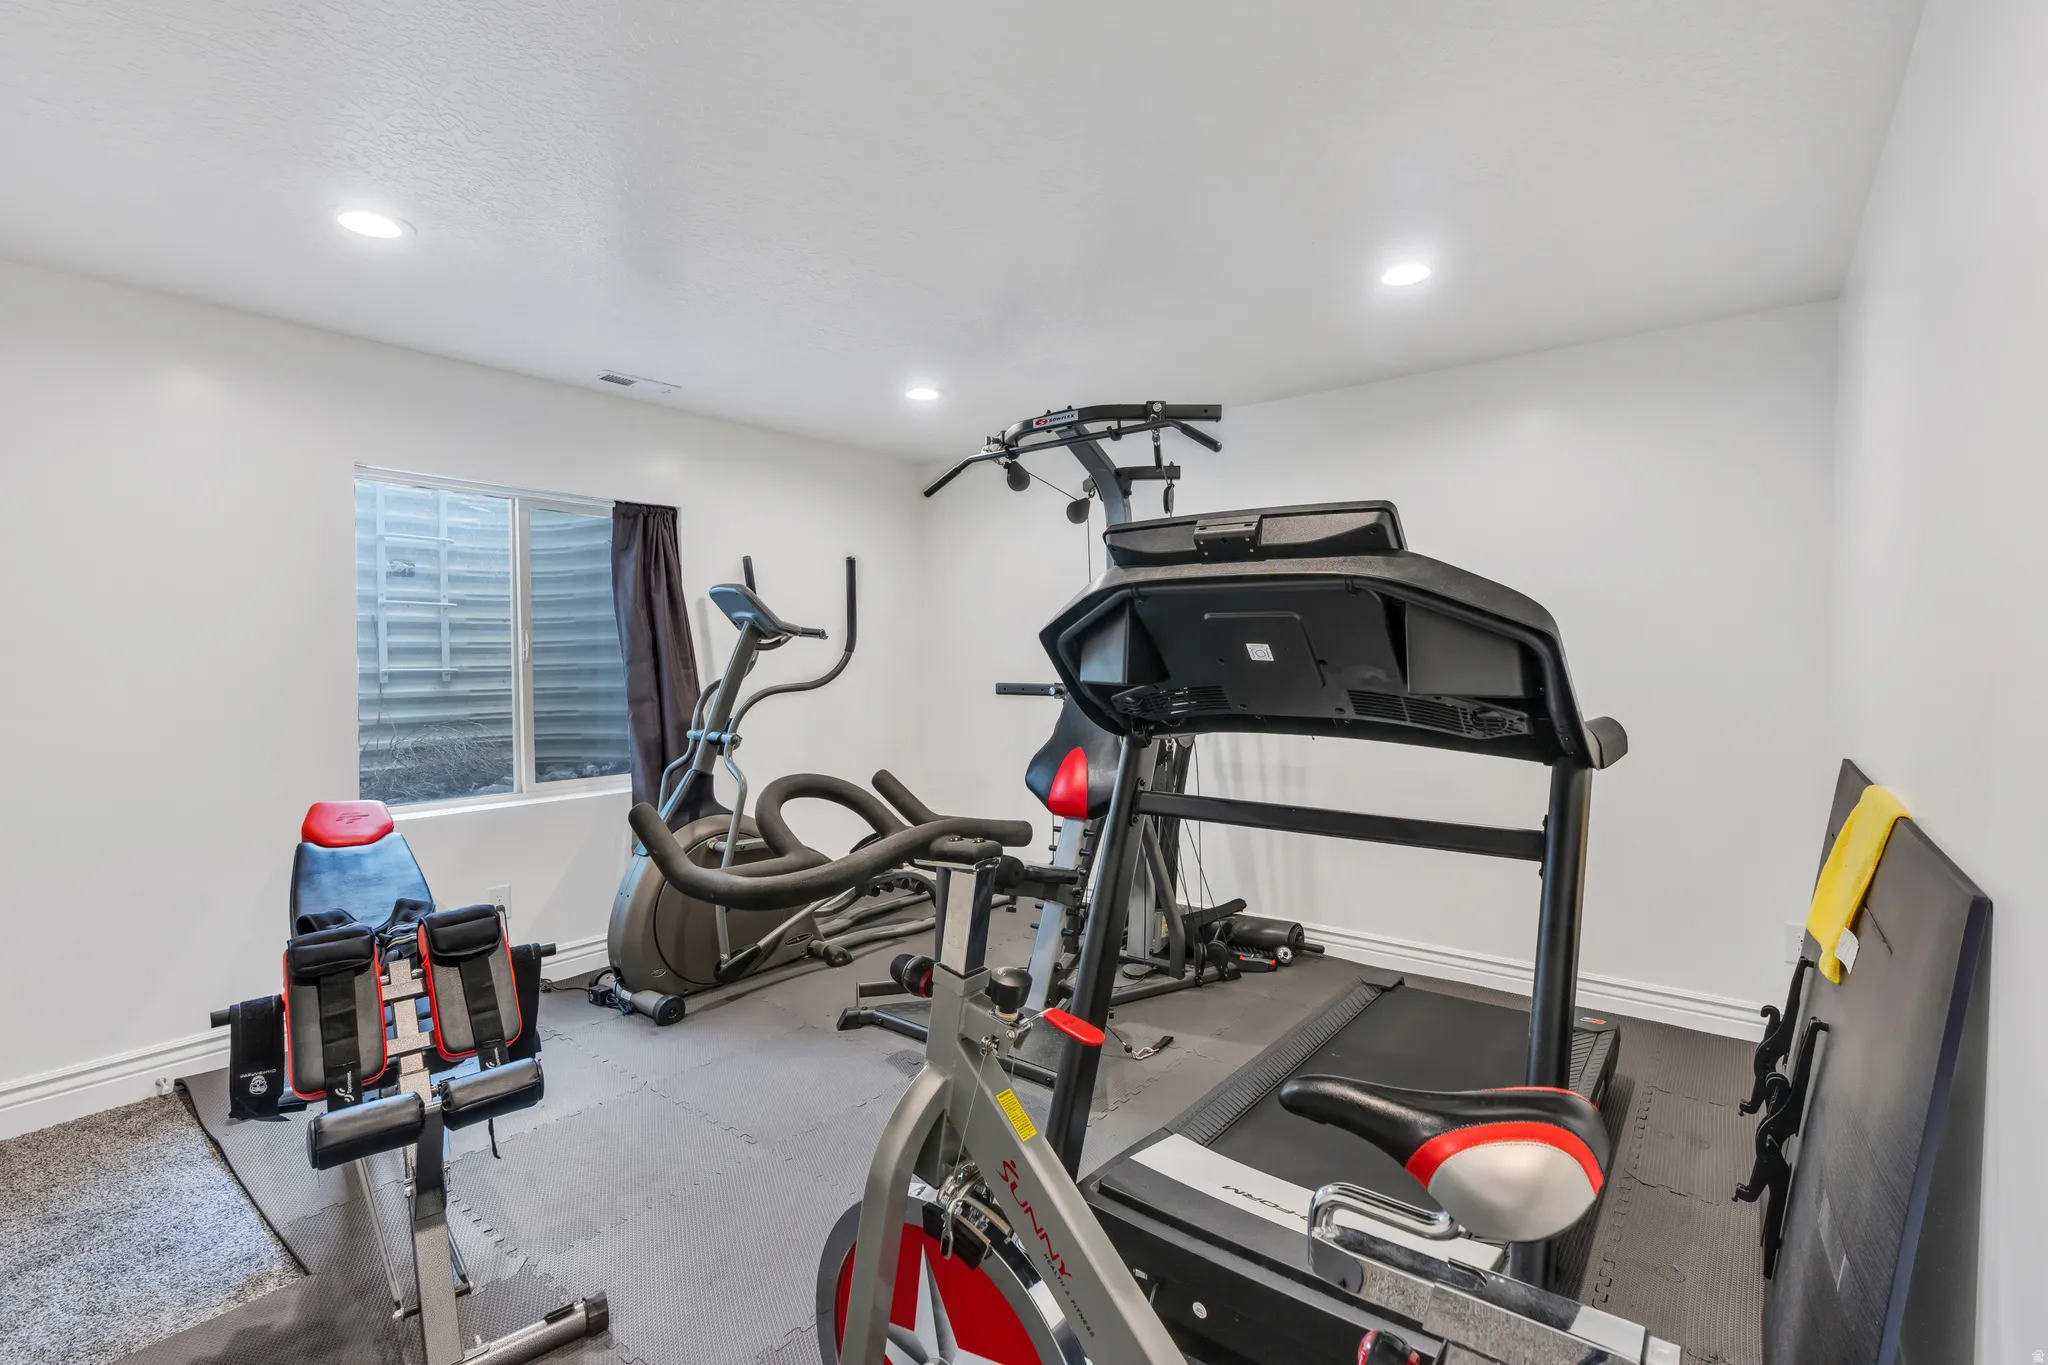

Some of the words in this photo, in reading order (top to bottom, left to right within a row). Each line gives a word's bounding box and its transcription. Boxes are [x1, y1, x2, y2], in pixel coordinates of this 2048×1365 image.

[1048, 413, 1075, 423] BOWFLEX
[996, 1159, 1073, 1278] SUNNY
[1043, 1253, 1066, 1288] HEALTH
[1070, 1299, 1096, 1339] FITNESS
